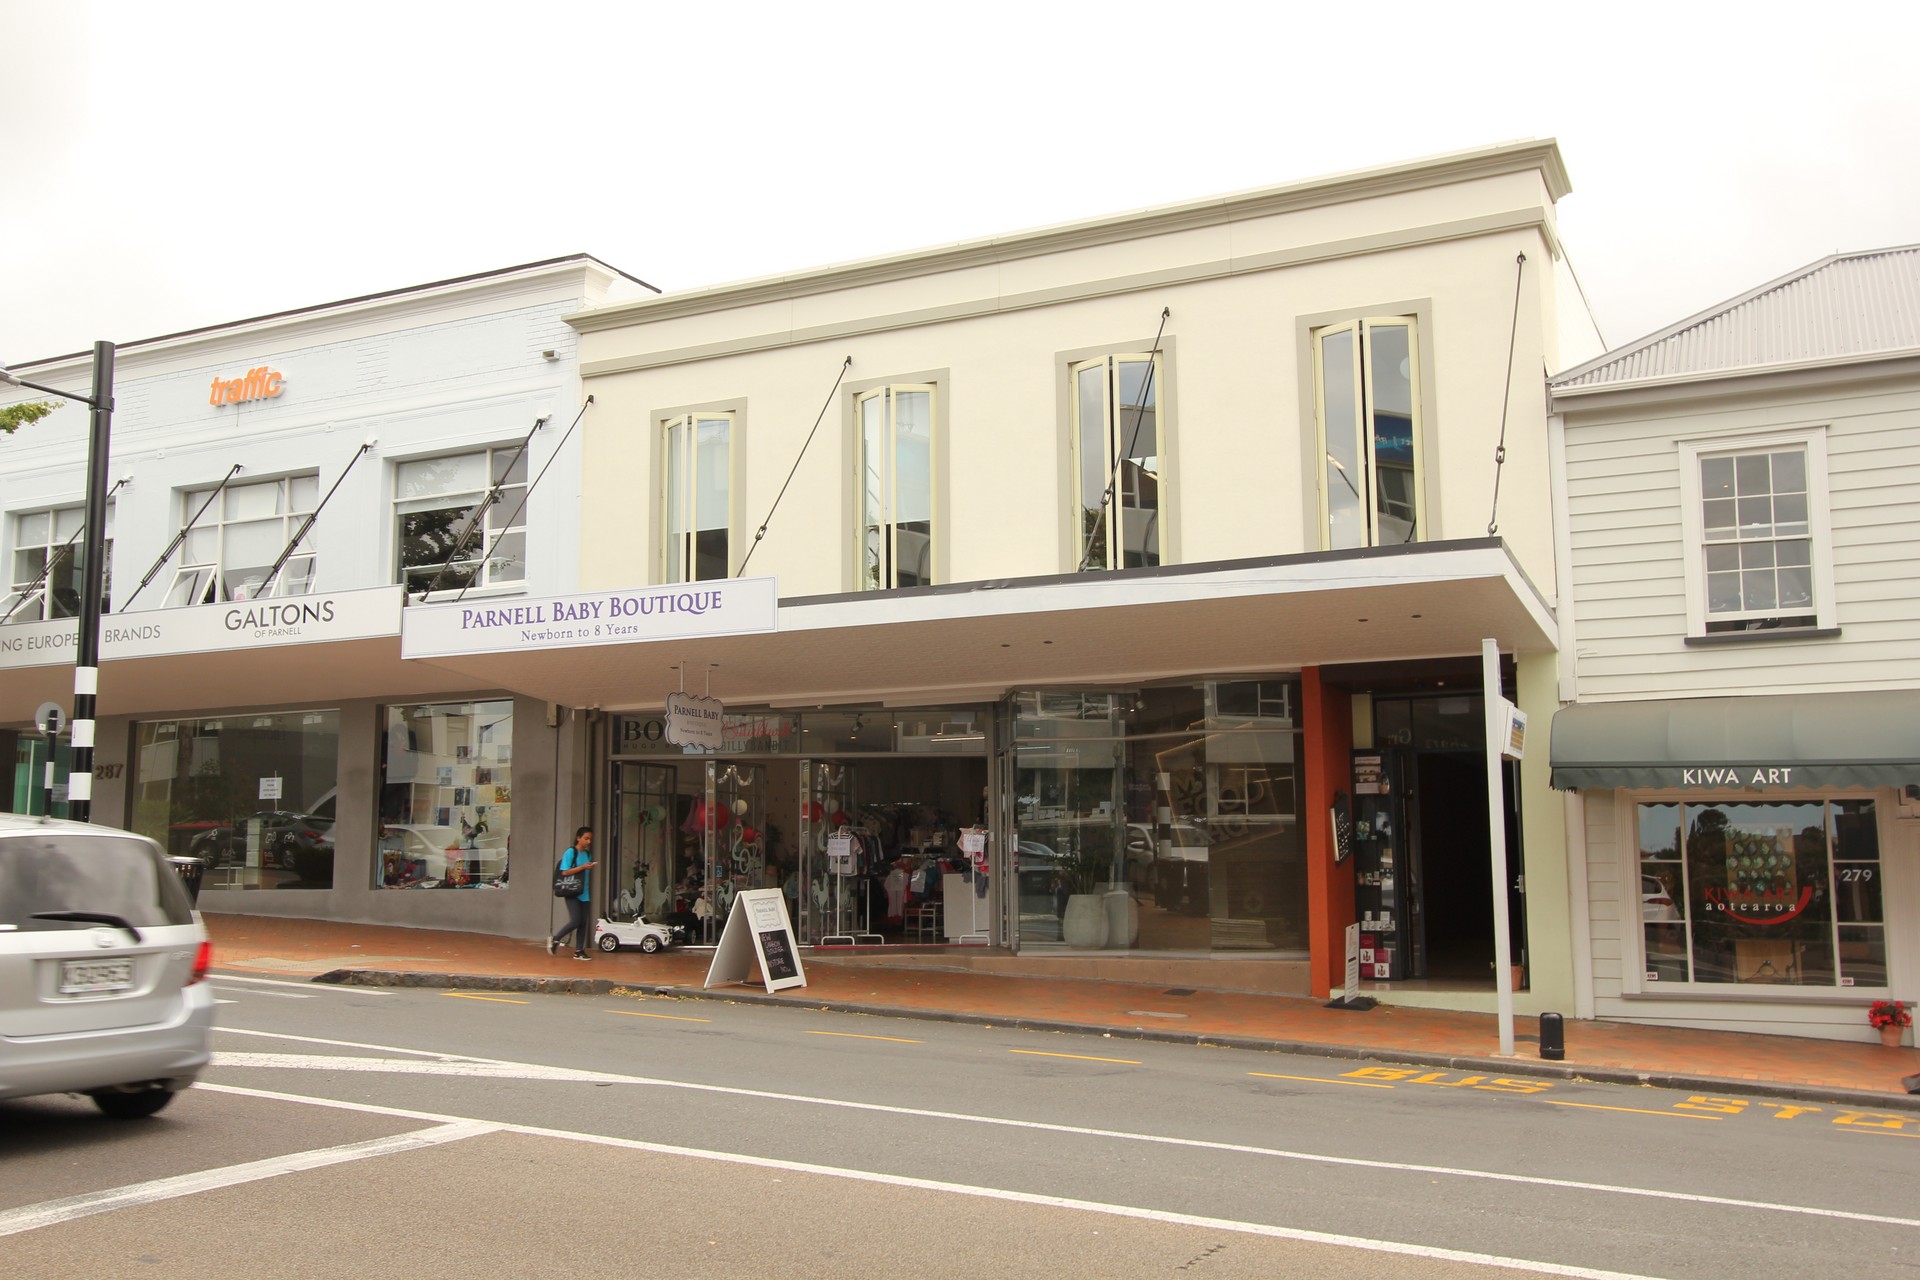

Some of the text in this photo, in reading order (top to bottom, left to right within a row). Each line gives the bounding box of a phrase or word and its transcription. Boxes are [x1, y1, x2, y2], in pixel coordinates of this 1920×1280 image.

[209, 366, 284, 406] traffic
[225, 600, 334, 631] GALTONS
[461, 591, 722, 629] PARNELL BABY BOUTIQUE
[1, 625, 161, 652] NG EUROPE BRANDS
[254, 627, 302, 639] OF PARNELL
[521, 623, 639, 641] Newborn to 8 Years
[674, 704, 720, 720] PARNELL BABY
[624, 719, 664, 741] BO
[95, 763, 124, 780] 287
[1683, 768, 1792, 784] KIWA ART
[1842, 869, 1873, 882] 279
[1704, 887, 1795, 900] KIWA ART
[1705, 902, 1797, 912] aotearoa
[1338, 1066, 1555, 1094] BUS
[1673, 1095, 1920, 1129] STO
